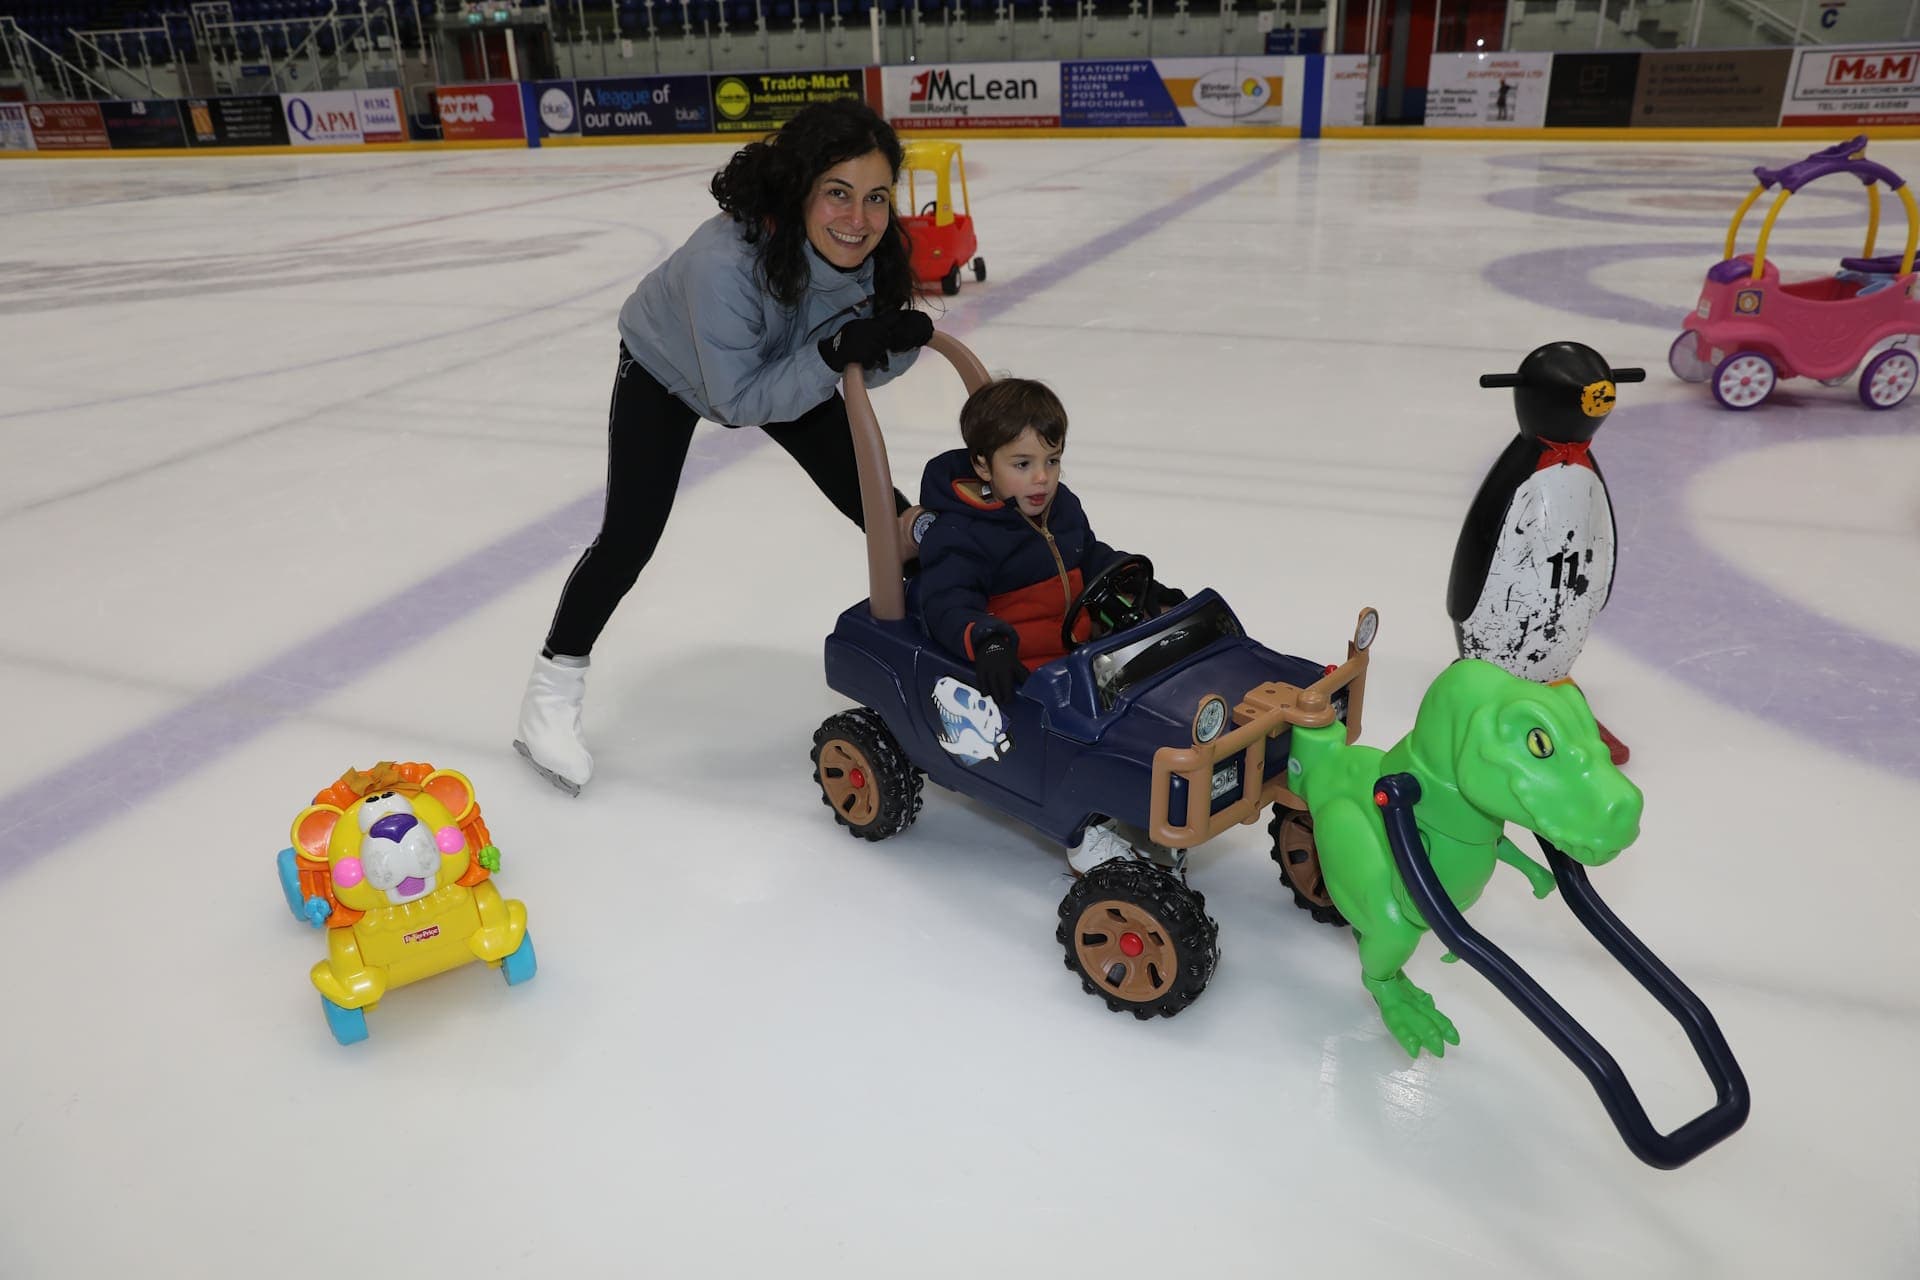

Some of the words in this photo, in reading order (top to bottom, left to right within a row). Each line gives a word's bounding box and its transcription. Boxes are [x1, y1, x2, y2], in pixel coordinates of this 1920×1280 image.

[1821, 8, 1839, 29] C
[1071, 63, 1149, 73] STATIONERY
[1834, 57, 1912, 81] M&M
[759, 73, 849, 91] Trade-Mart
[928, 69, 1038, 101] McLean
[1071, 73, 1129, 82] BANNERS
[1071, 82, 1109, 90] SIGNS
[582, 87, 595, 107] A
[597, 87, 650, 110] league
[652, 84, 671, 104] of
[1071, 90, 1126, 99] POSTERS
[1071, 99, 1145, 108] BROCHURES
[927, 103, 969, 115] Roofing
[585, 112, 610, 128] our
[613, 109, 653, 128] own.
[1546, 551, 1579, 589] 11
